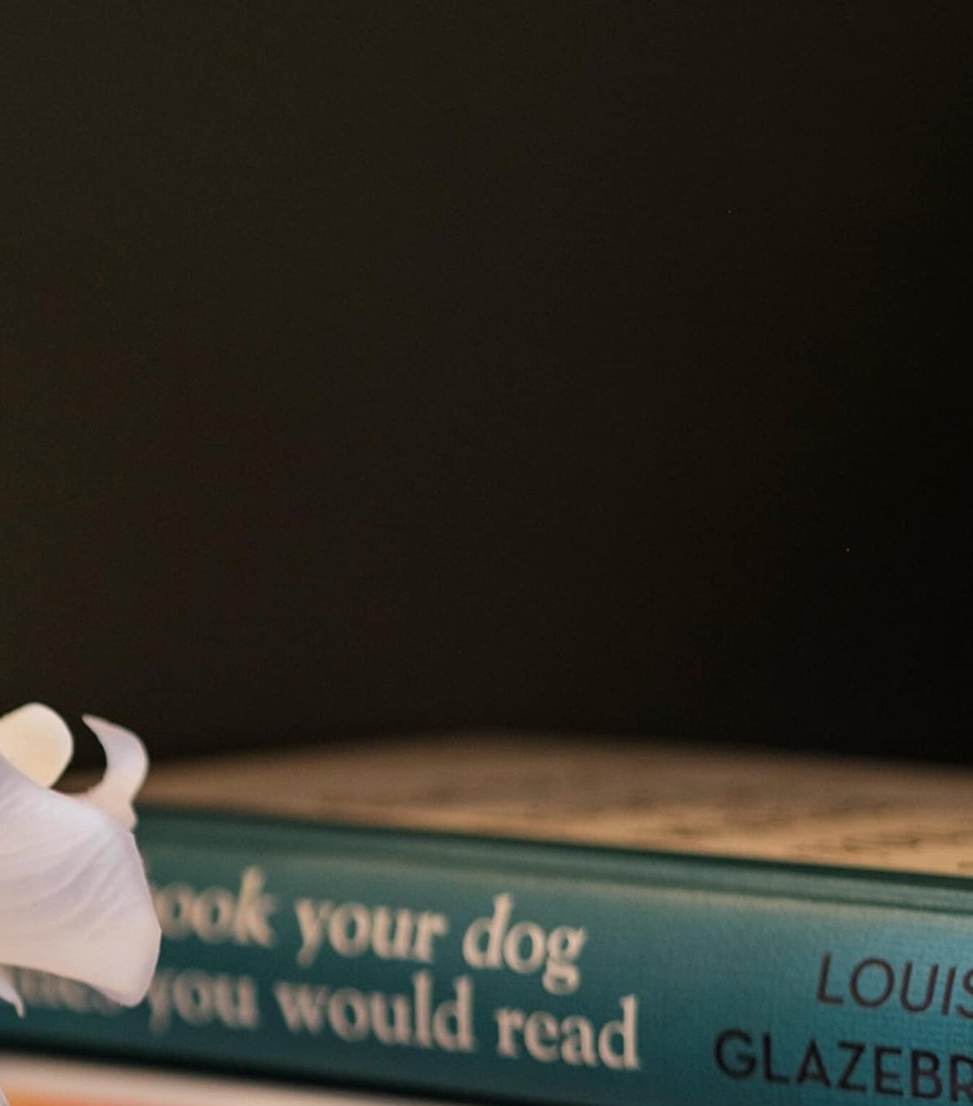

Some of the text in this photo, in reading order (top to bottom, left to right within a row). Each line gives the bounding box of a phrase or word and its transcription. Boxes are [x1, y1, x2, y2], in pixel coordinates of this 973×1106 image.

[148, 865, 588, 995] ook your dog
[146, 967, 259, 1038] you
[274, 969, 476, 1051] would
[494, 993, 641, 1071] read
[816, 952, 973, 1018] LOUIS
